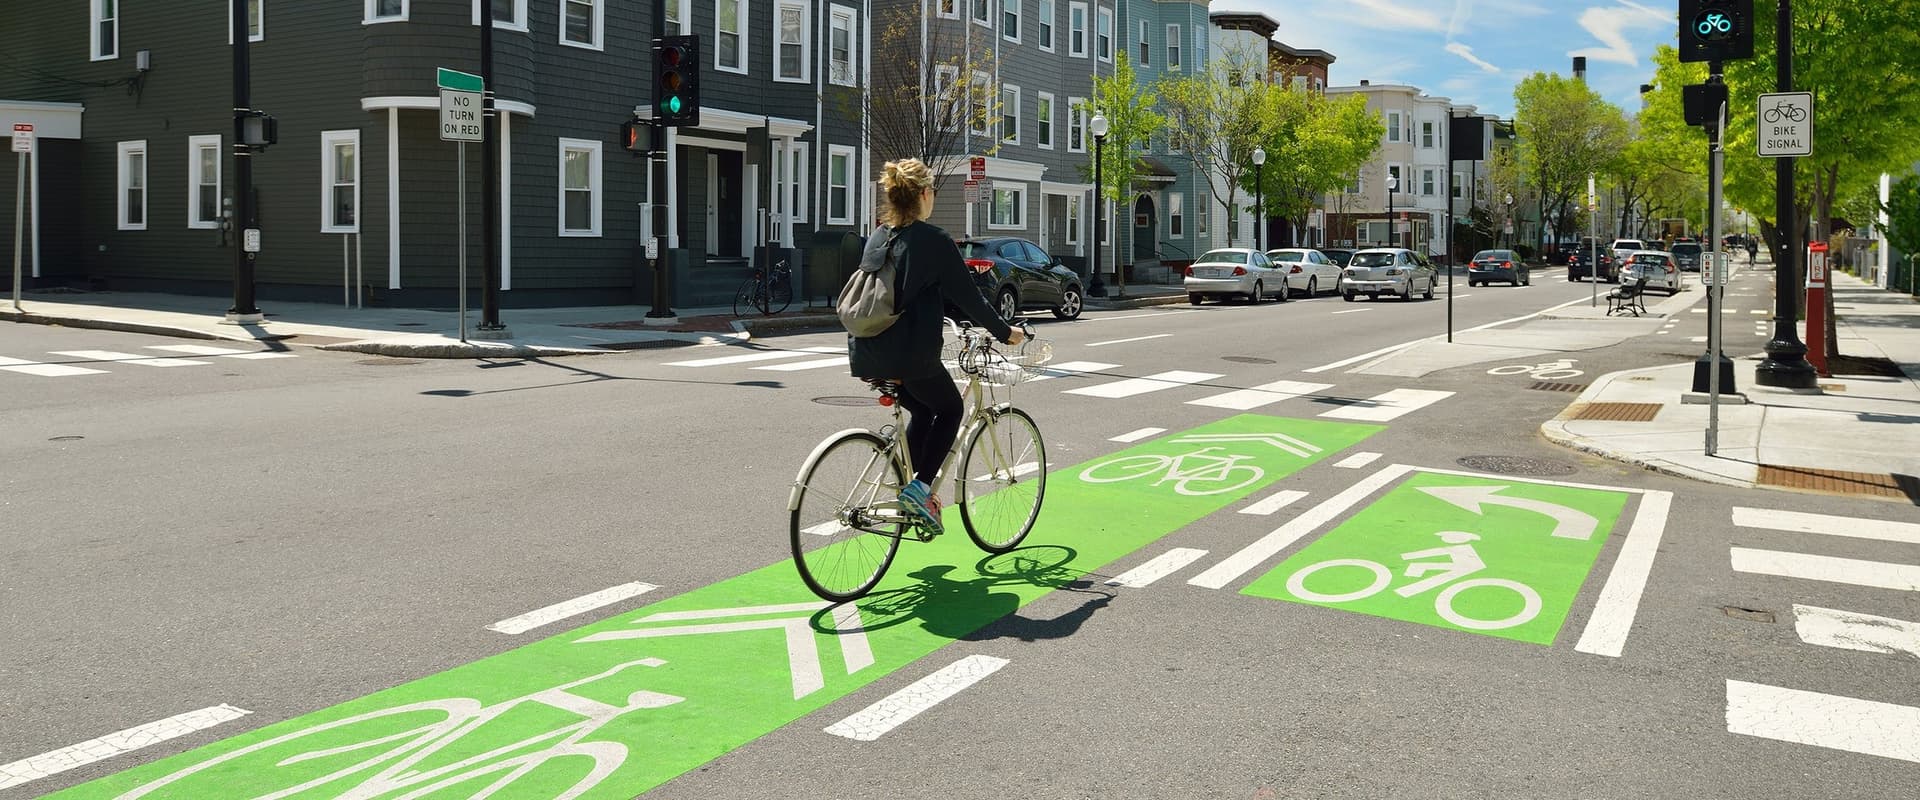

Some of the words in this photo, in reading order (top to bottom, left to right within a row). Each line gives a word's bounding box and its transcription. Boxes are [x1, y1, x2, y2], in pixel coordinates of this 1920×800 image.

[454, 96, 470, 107] NO
[449, 110, 474, 121] TURN
[444, 123, 458, 134] ON
[461, 125, 480, 135] RED
[1773, 126, 1797, 136] BIKE
[1767, 139, 1803, 149] SIGNAL
[1814, 252, 1822, 279] FIRE
